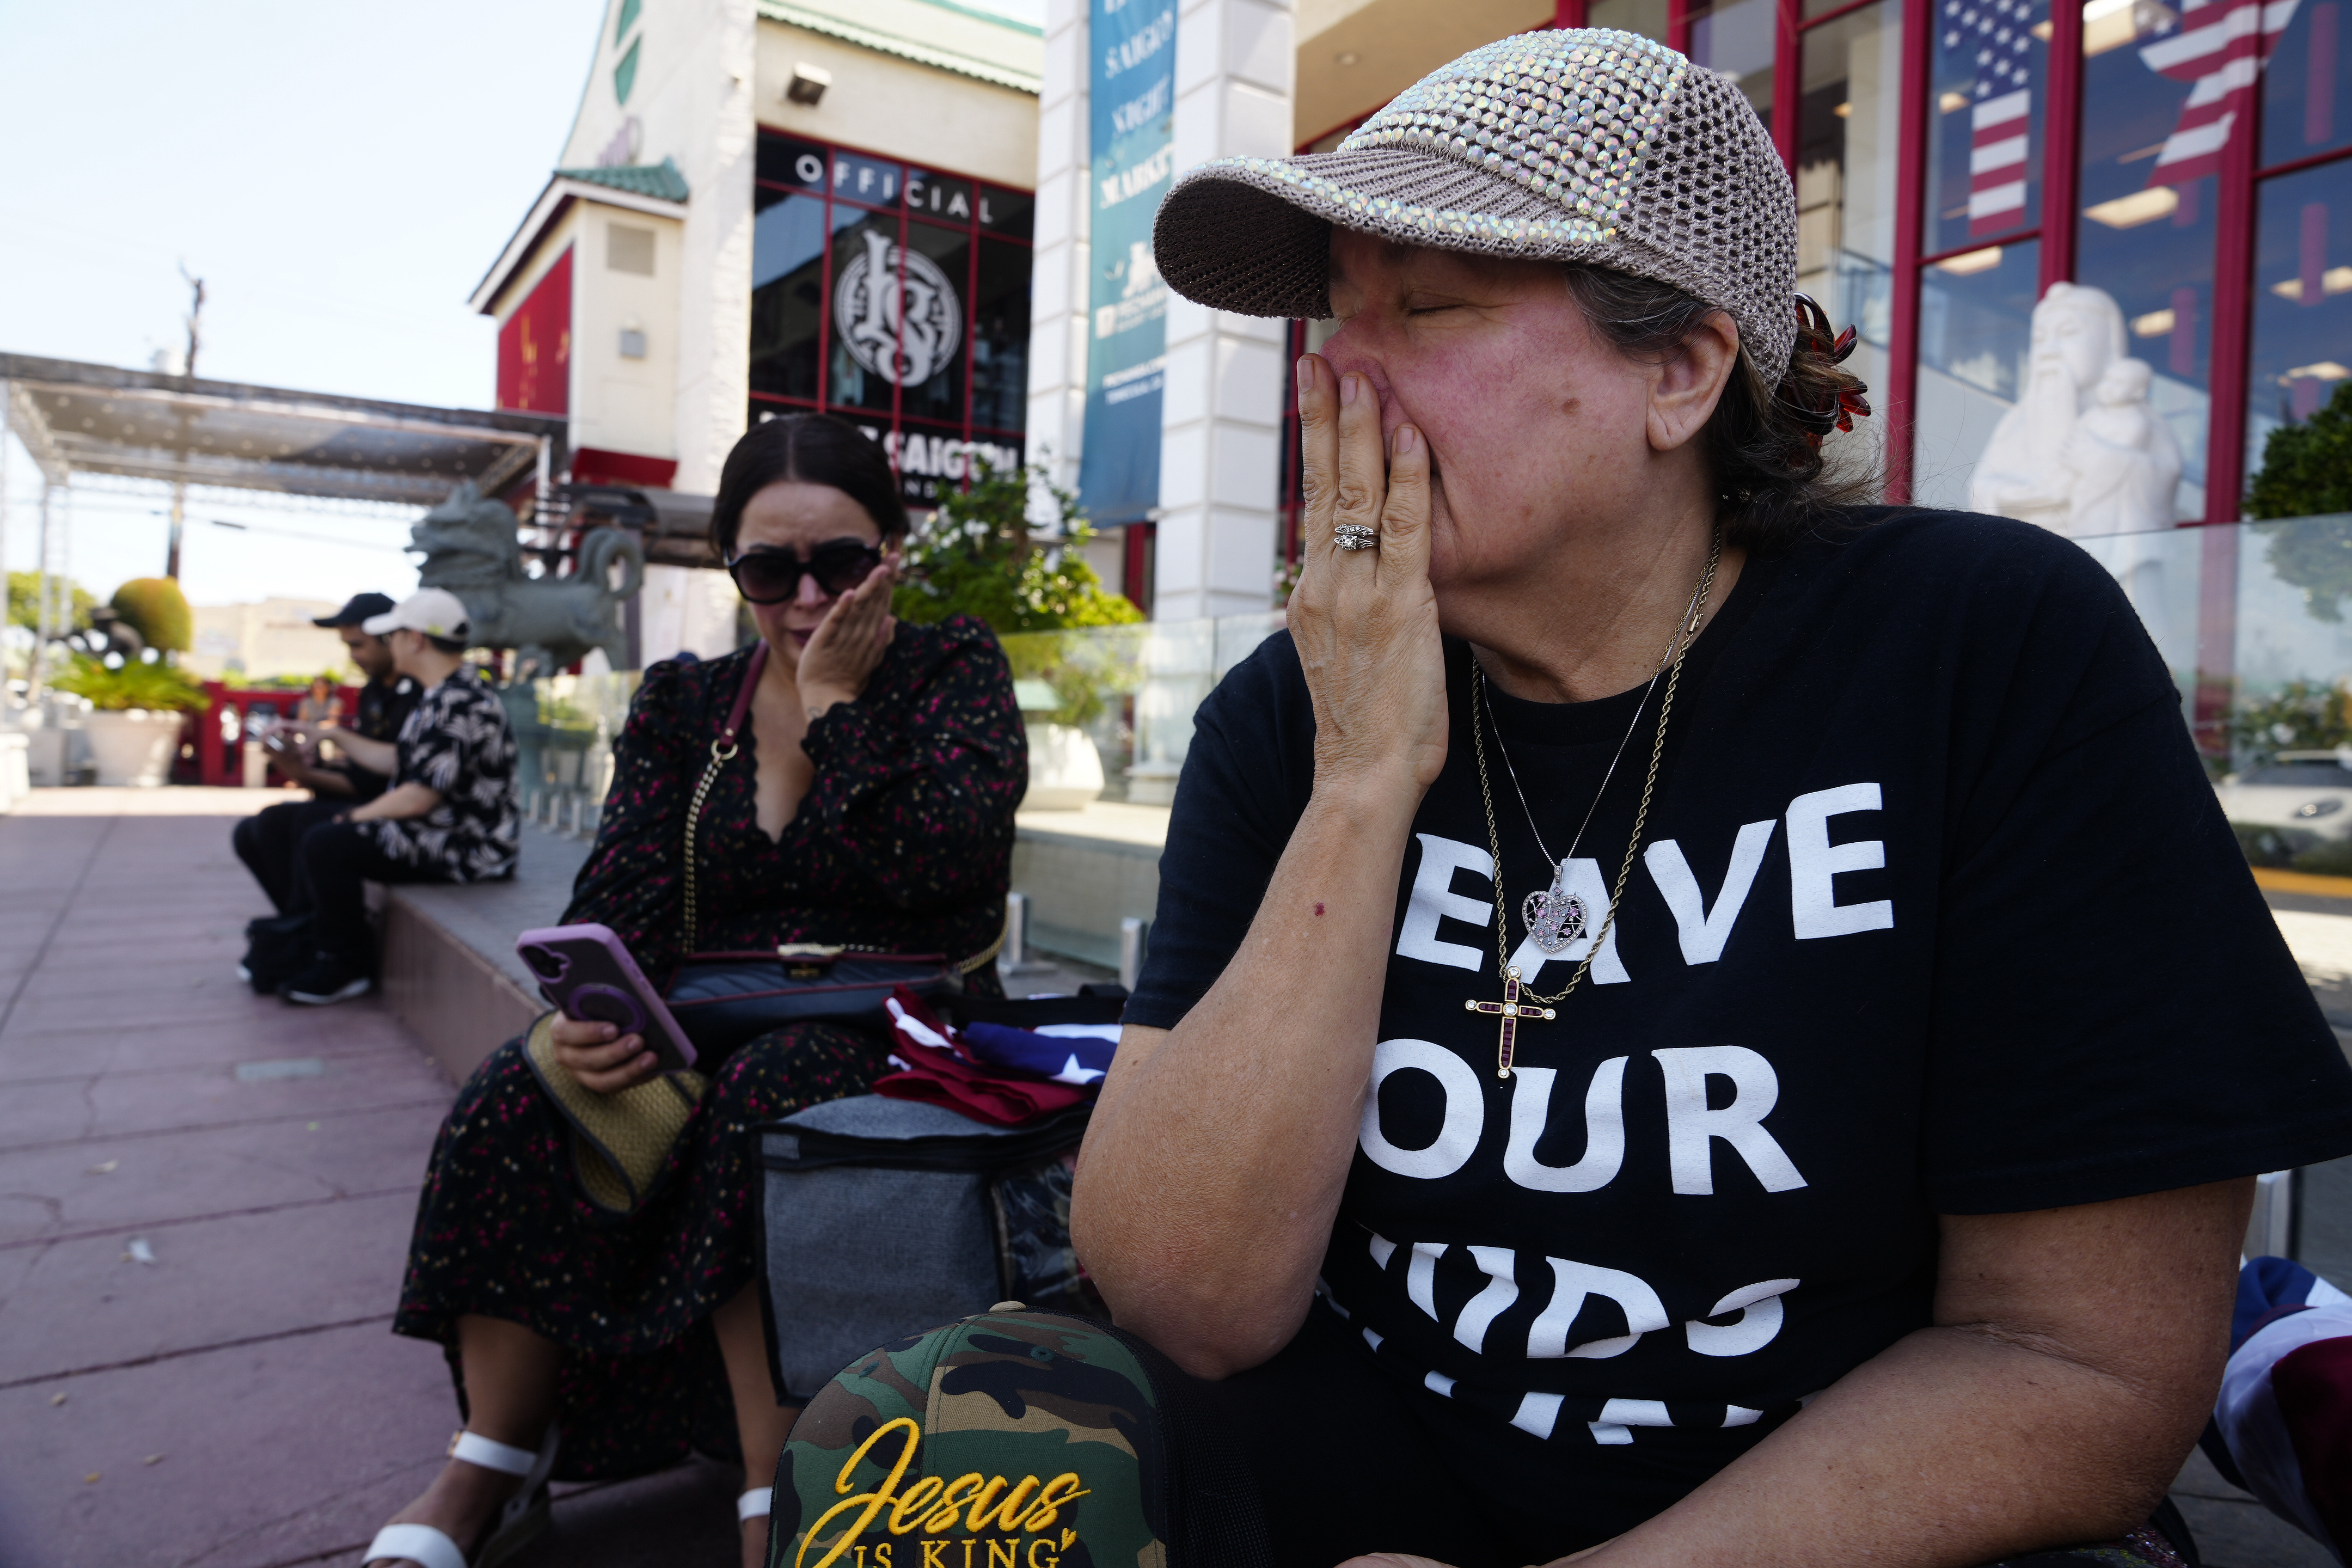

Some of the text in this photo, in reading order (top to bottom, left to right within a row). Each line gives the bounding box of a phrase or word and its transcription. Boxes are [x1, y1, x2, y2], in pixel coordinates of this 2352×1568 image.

[795, 154, 993, 223] OFFICIAL
[1396, 782, 1894, 985] EAVE
[1358, 1038, 1808, 1195] OUR
[795, 1417, 1091, 1568] Jesus
[853, 1539, 1060, 1568] IS KING
